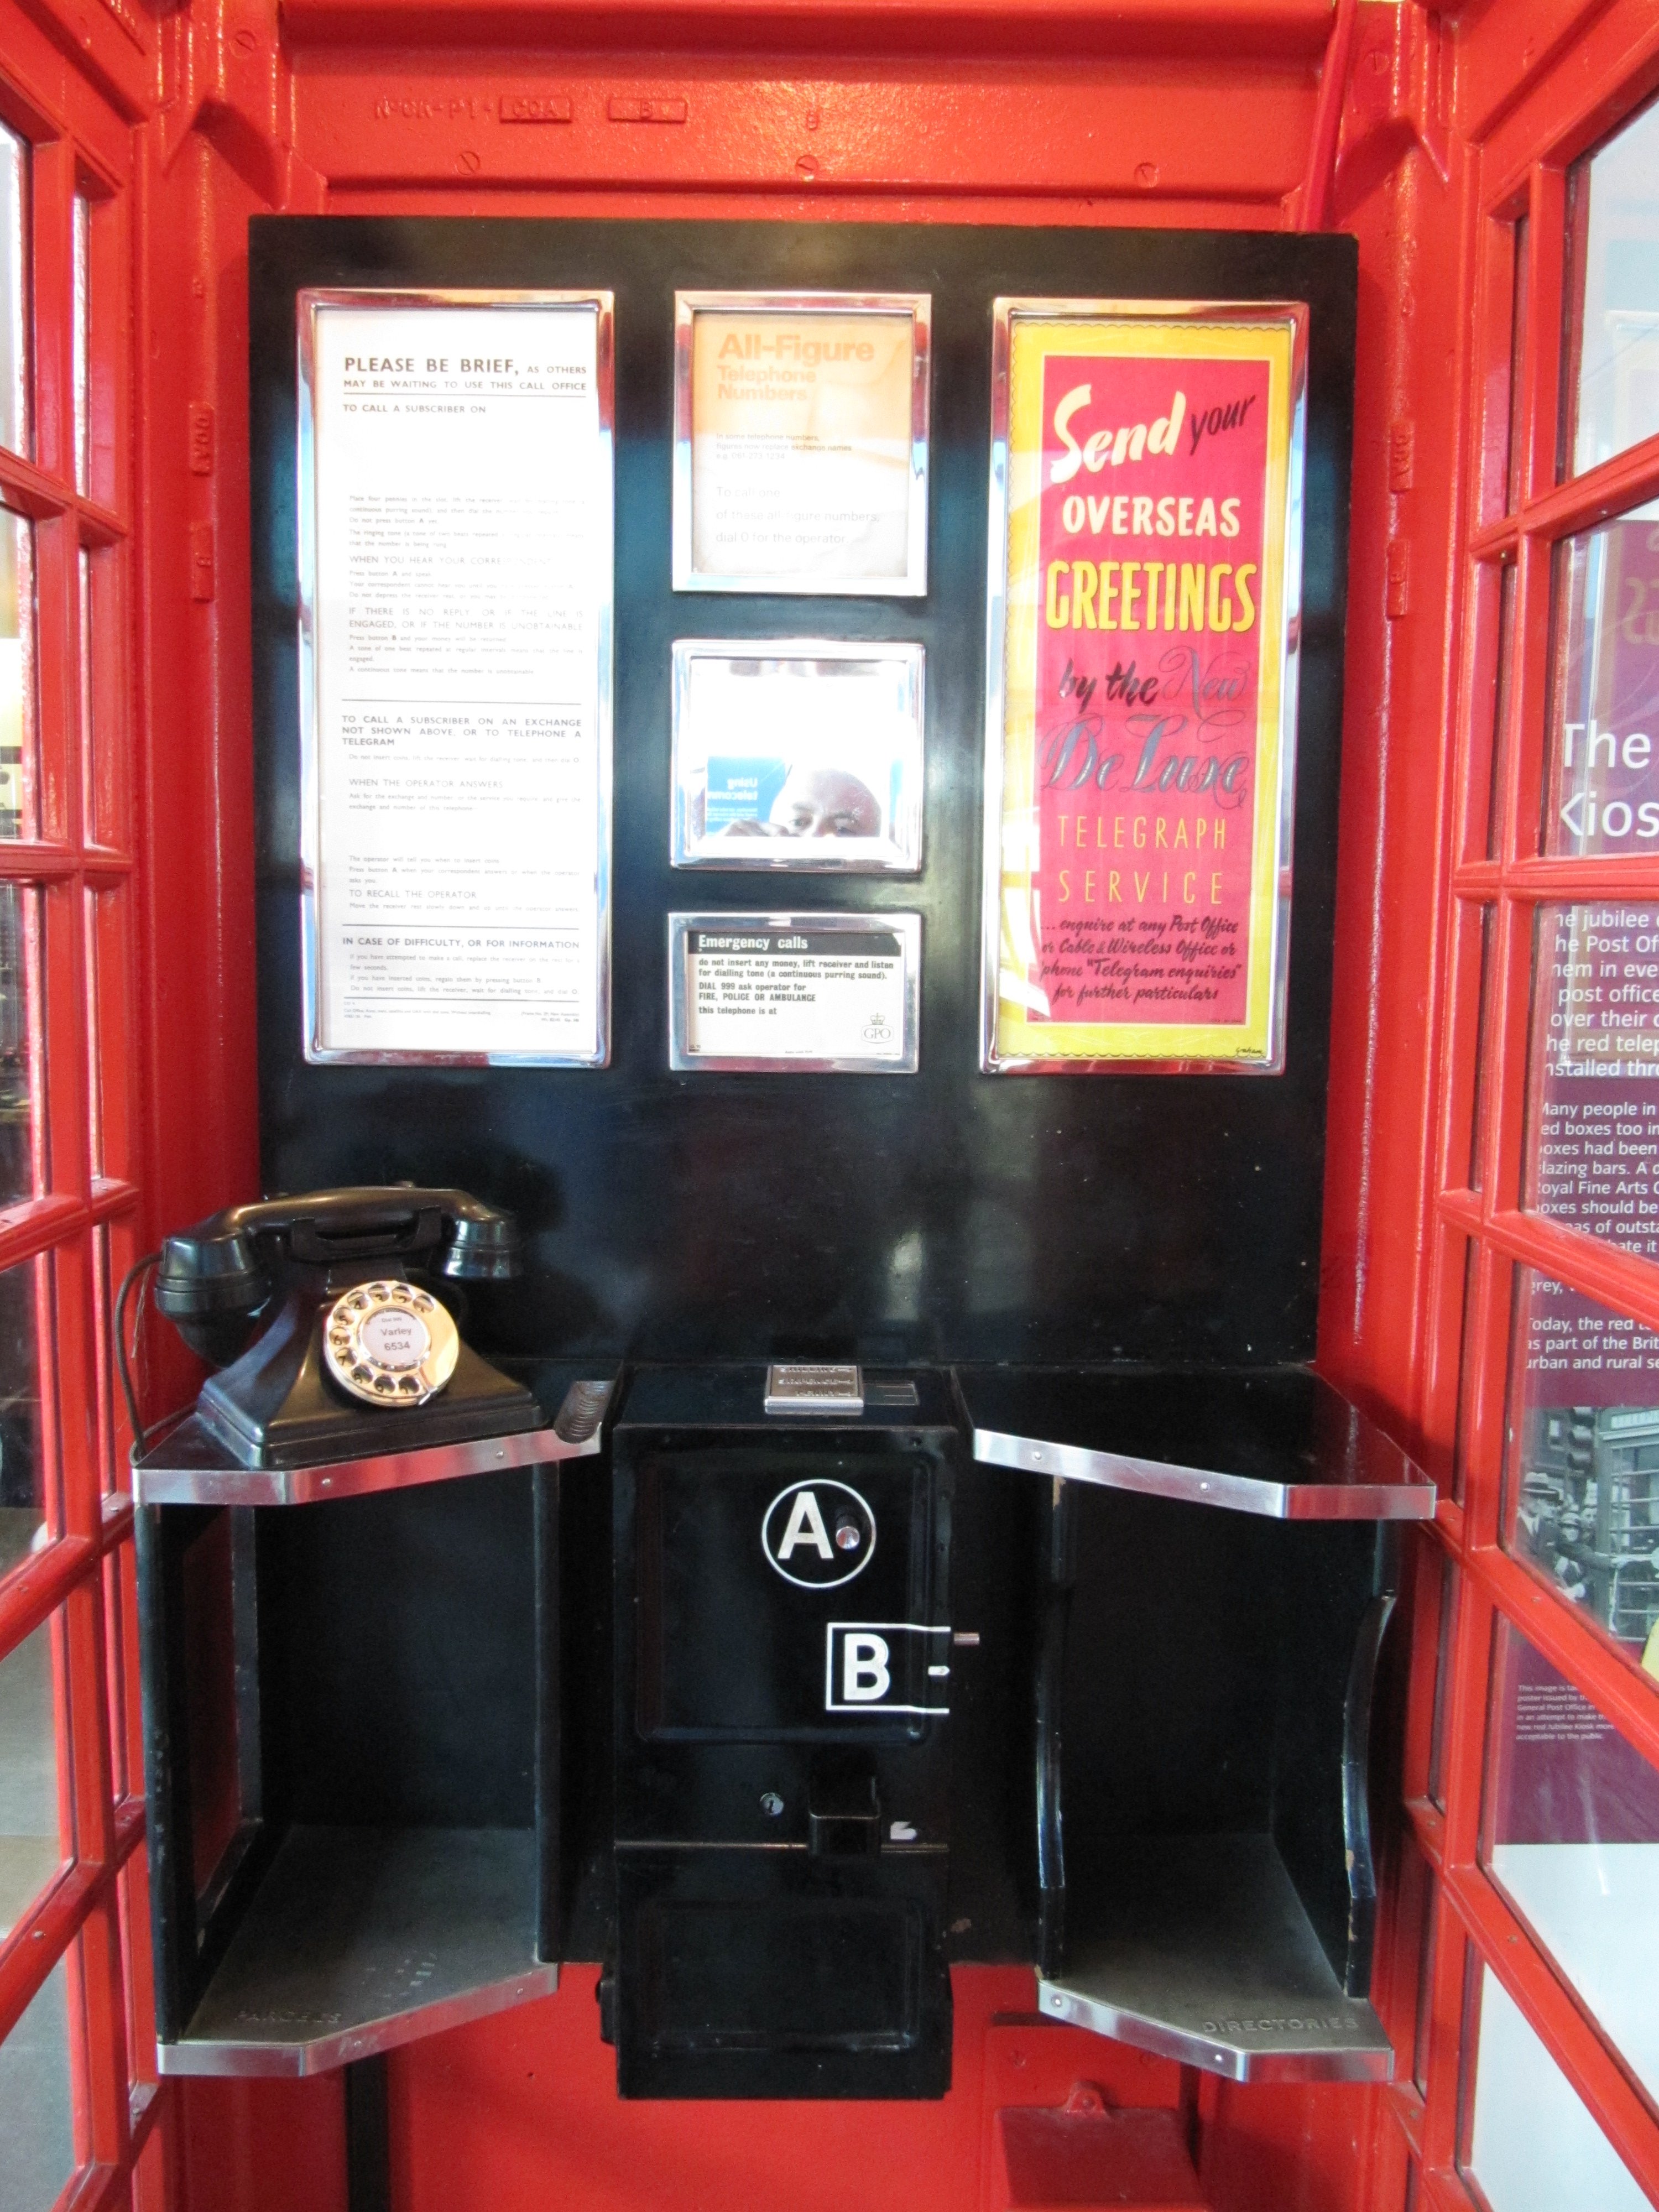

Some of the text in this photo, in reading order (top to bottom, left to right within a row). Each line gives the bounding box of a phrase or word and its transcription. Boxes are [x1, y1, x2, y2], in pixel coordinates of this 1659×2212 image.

[718, 333, 874, 367] All-Figure
[345, 357, 414, 373] PLEASE
[426, 358, 449, 373] BE
[461, 358, 519, 376] BRIEF,
[546, 366, 586, 374] OTHERS
[717, 365, 816, 385] Telephone
[718, 384, 807, 401] Numbers
[405, 405, 465, 413] SUBSCRIBER
[1050, 383, 1256, 484] Send your
[1062, 495, 1241, 538] OVERSEAS
[1046, 560, 1258, 633] GREETINGS
[1058, 645, 1251, 719] by the New
[525, 718, 582, 727] EXCHANGE
[1563, 720, 1651, 769] The
[1039, 713, 1249, 810] De Luxe
[1058, 816, 1225, 849] TELEGRAPH
[1058, 870, 1223, 904] SERVICE
[1060, 914, 1238, 938] enquire at any Post Office
[1582, 910, 1648, 932] jubilee
[358, 937, 382, 946] CASE
[404, 938, 464, 948] DIFFICULTY,
[509, 940, 580, 949] INFORMATION
[698, 935, 808, 951] Emergency calls
[1042, 938, 1235, 962] or Cable & Wireless Office or
[1587, 936, 1629, 953] Post
[699, 958, 708, 967] do
[712, 958, 724, 967] not
[755, 961, 769, 969] any
[772, 961, 800, 969] money,
[819, 960, 851, 968] receiver
[871, 961, 894, 969] listen
[1087, 958, 1165, 984] "Telegram
[1168, 964, 1241, 981] enquiries"
[1600, 961, 1616, 977] in
[714, 969, 744, 979] dialling
[767, 970, 776, 979] (a
[825, 972, 855, 980] purring
[858, 971, 887, 979] sound).
[755, 984, 790, 992] operator
[1053, 983, 1219, 1006] for further particulars
[1558, 985, 1603, 1006] post
[698, 993, 718, 1001] FIRE,
[723, 993, 749, 1001] POLICE
[770, 994, 816, 1002] AMBULANCE
[698, 1006, 714, 1015] this
[717, 1007, 755, 1015] telephone
[1551, 1010, 1647, 1027] over their
[863, 1027, 891, 1040] GPO
[1577, 1034, 1609, 1051] red
[1583, 1102, 1637, 1119] people
[1642, 1102, 1656, 1115] in
[1565, 1121, 1611, 1135] boxes
[1616, 1123, 1642, 1135] too
[1584, 1141, 1657, 1155] had been
[1539, 1161, 1647, 1178] lazing bars. A
[1538, 1181, 1648, 1197] oyal Fine Arts
[1582, 1200, 1658, 1214] should be
[1595, 1219, 1611, 1233] of
[1647, 1240, 1657, 1253] it
[1530, 1317, 1634, 1333] oday, the red
[384, 1341, 410, 1350] 6534
[1546, 1338, 1578, 1353] part
[1582, 1336, 1599, 1350] of
[1603, 1337, 1627, 1350] the
[1573, 1356, 1601, 1369] and
[1606, 1355, 1641, 1369] rural
[778, 1491, 834, 1559] A
[843, 1633, 890, 1700] B
[1202, 2017, 1359, 2033] DIRECTORIES
